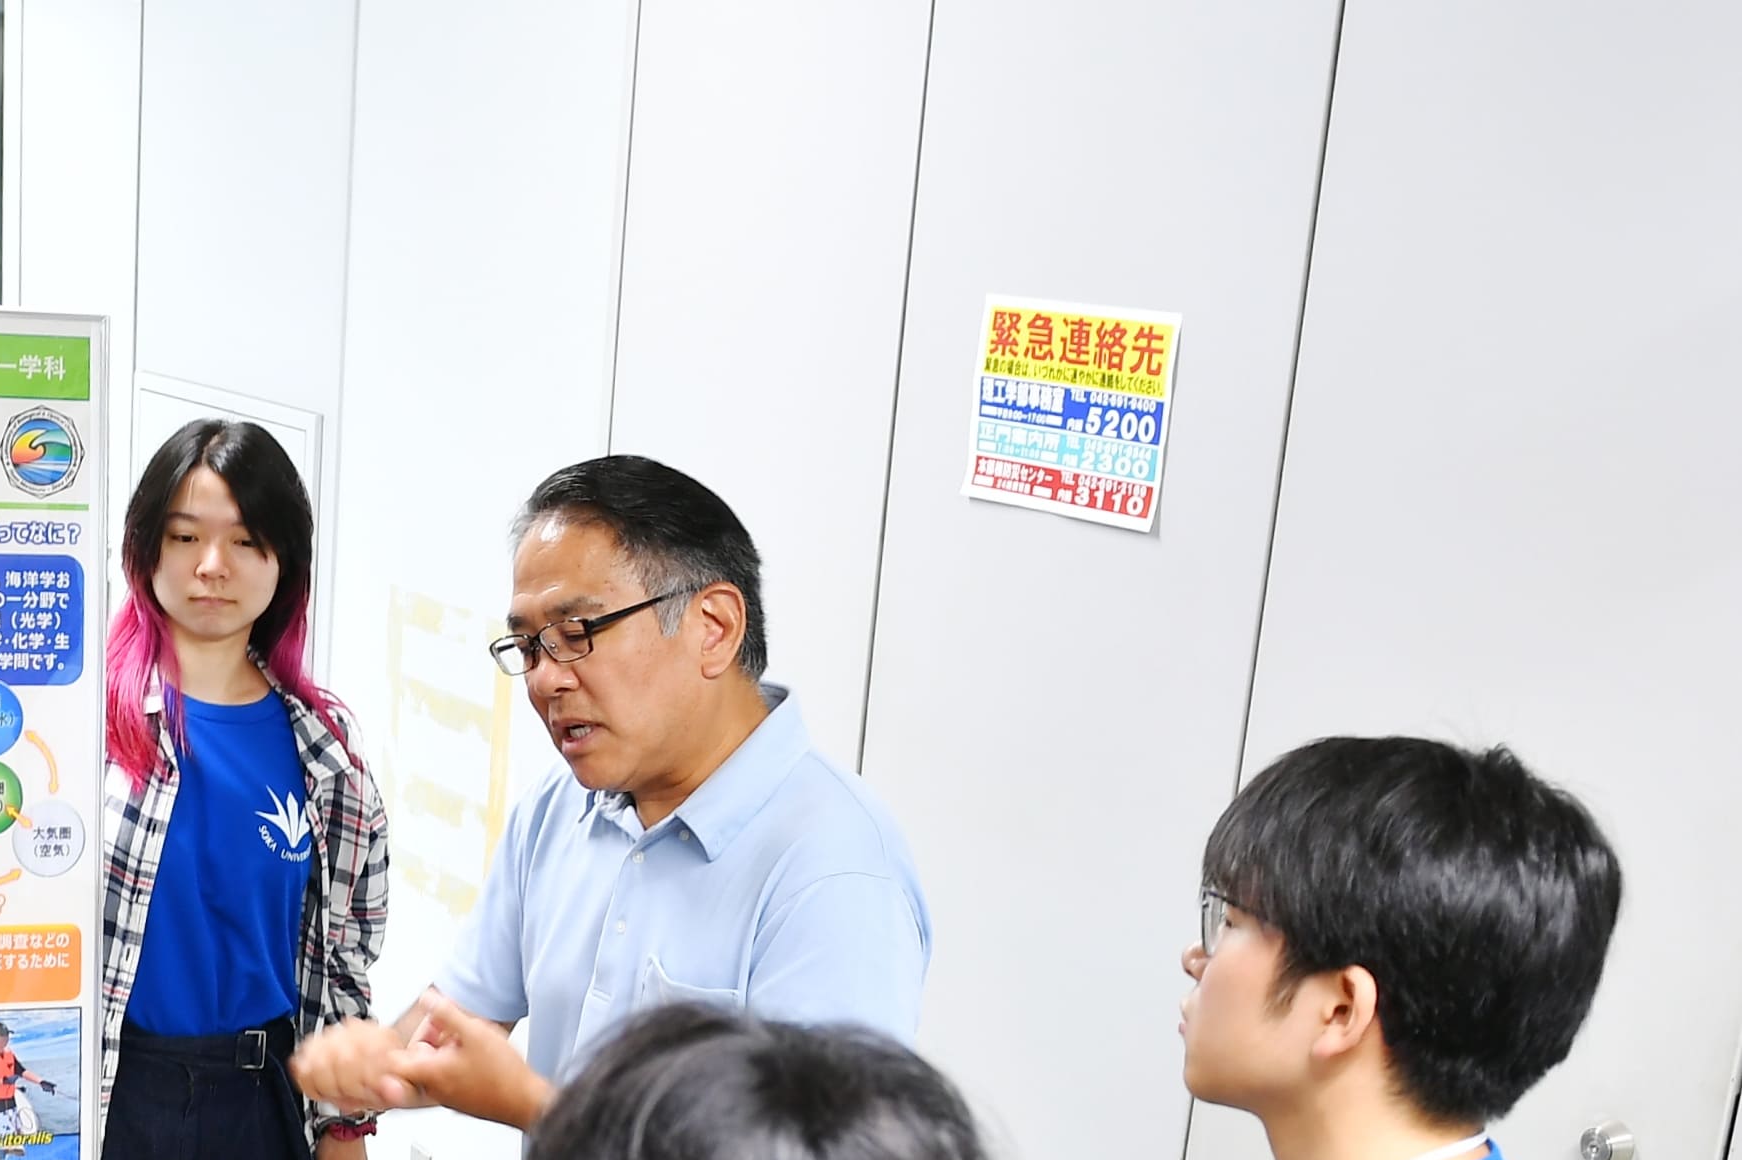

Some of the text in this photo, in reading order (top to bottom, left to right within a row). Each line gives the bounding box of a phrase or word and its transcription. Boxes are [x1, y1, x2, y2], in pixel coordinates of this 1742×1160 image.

[988, 310, 1164, 377] 緊急連絡先
[1085, 405, 1156, 444] 5200
[1081, 451, 1149, 481] 2300
[1075, 485, 1145, 517] 3110
[33, 826, 72, 840] 大気圏
[259, 824, 277, 852] SOKA
